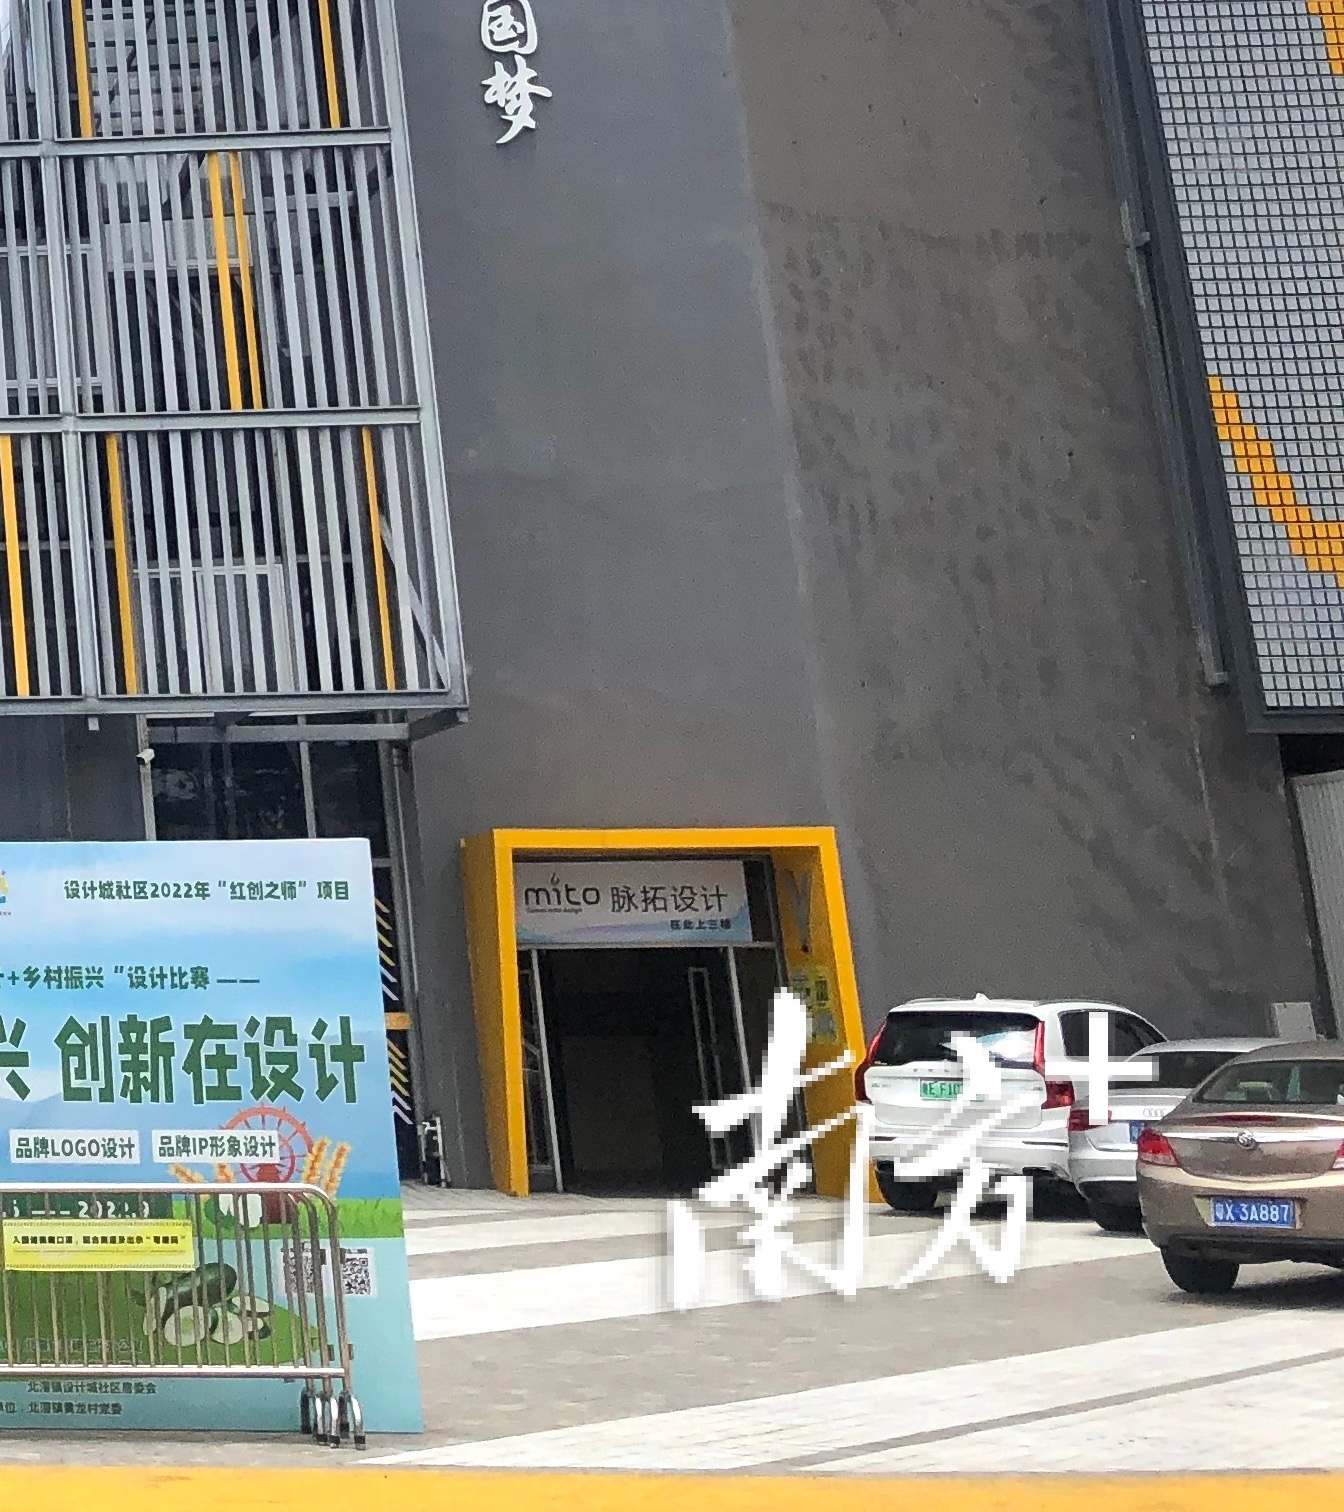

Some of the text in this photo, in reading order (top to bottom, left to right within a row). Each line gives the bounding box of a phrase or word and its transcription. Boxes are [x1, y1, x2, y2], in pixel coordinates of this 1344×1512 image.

[524, 872, 728, 913] mito 脉拓设计
[54, 1014, 365, 1105] 创新在设计
[15, 1136, 136, 1160] 品牌LOGO设计
[158, 1134, 277, 1159] 品牌IP形象设计
